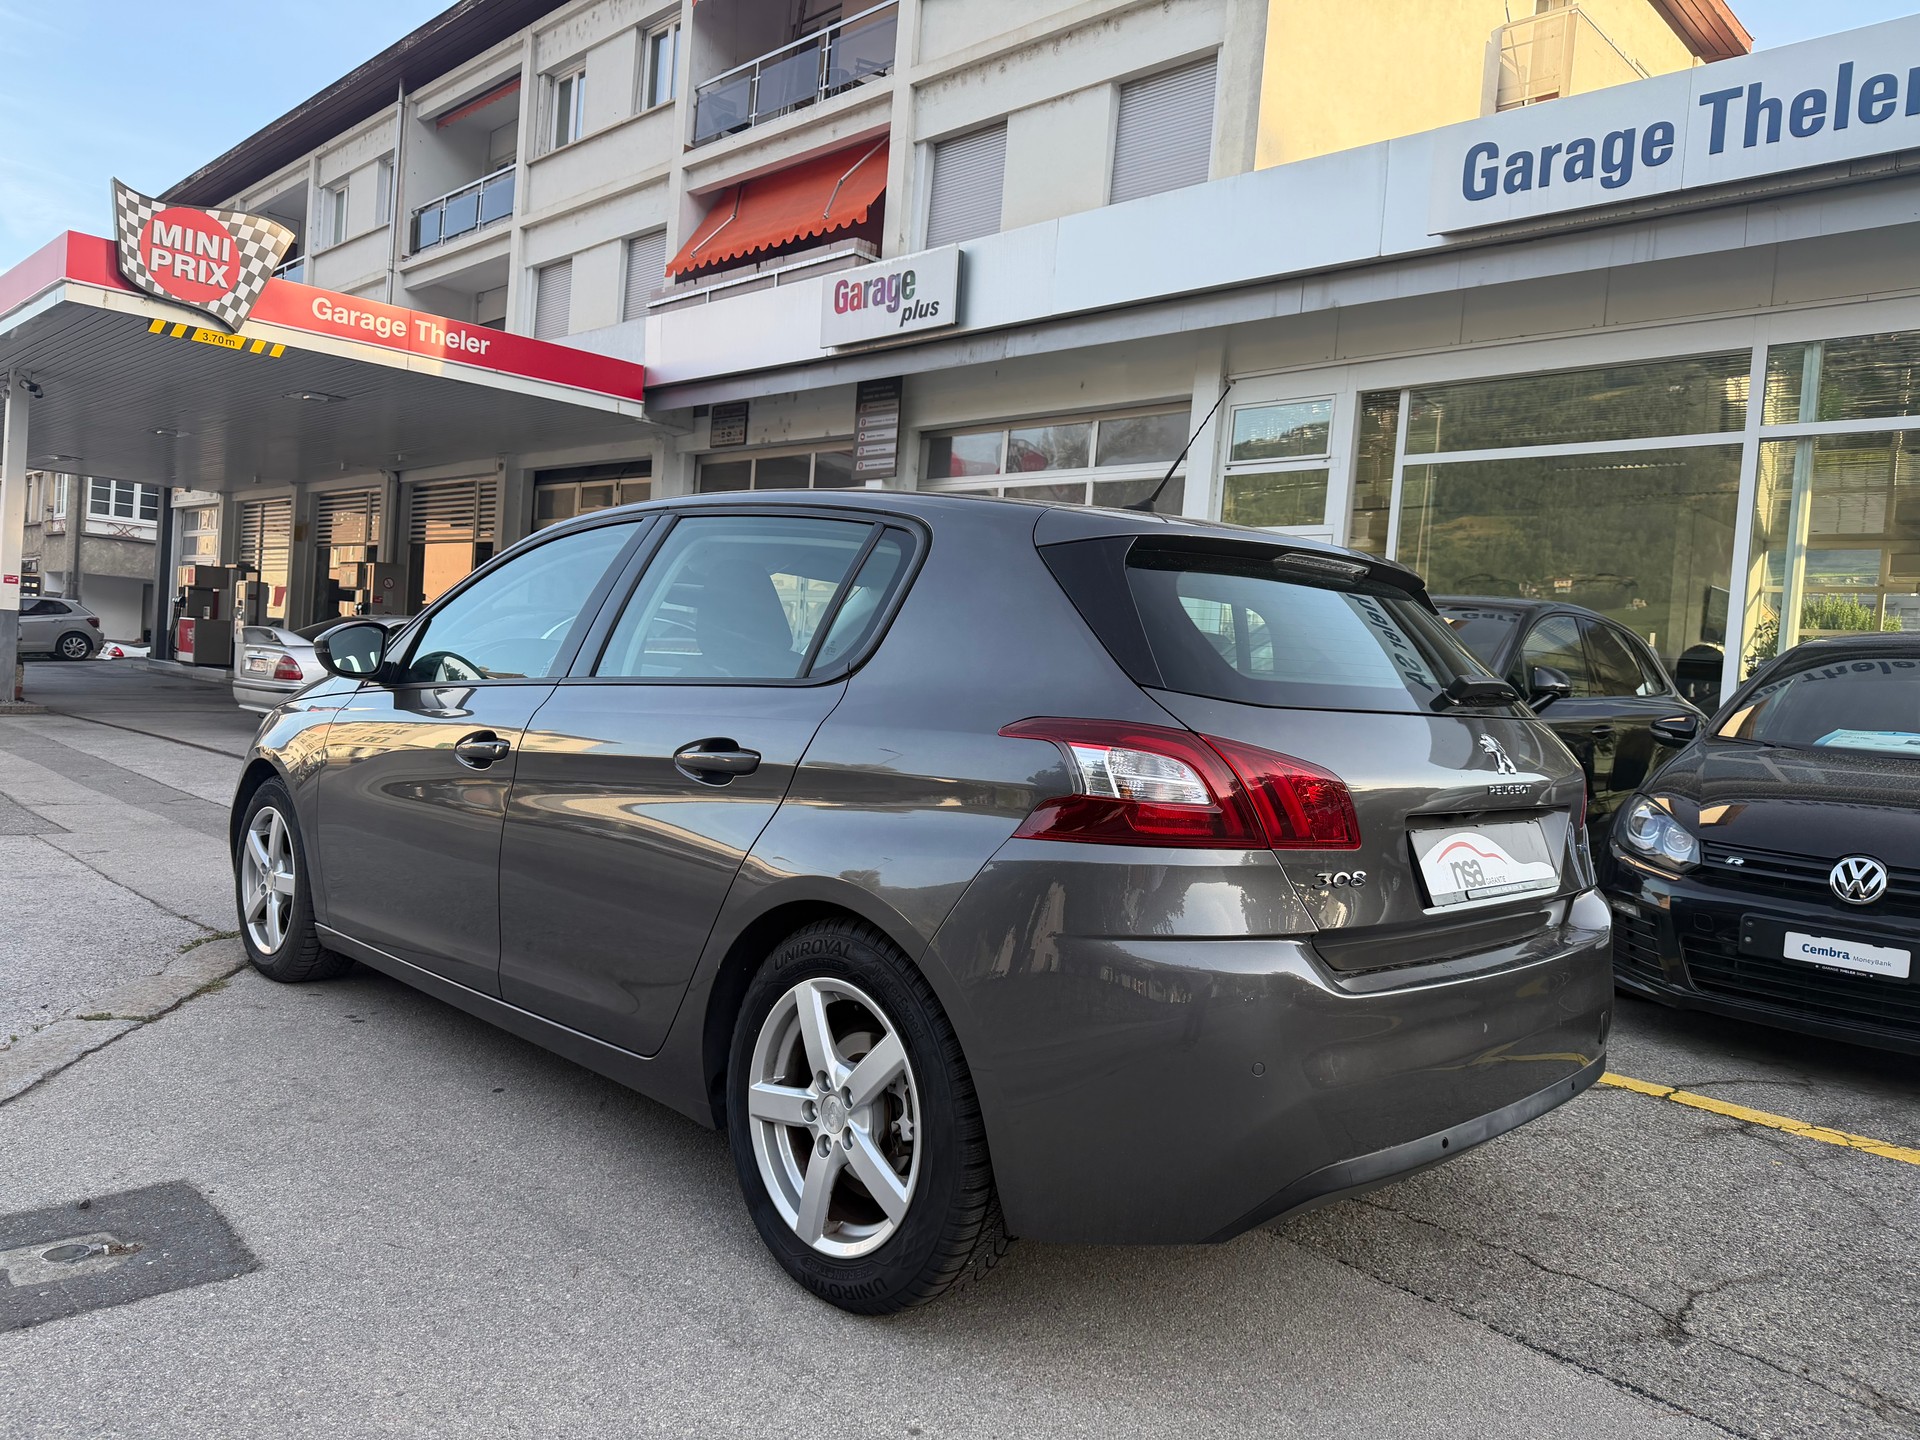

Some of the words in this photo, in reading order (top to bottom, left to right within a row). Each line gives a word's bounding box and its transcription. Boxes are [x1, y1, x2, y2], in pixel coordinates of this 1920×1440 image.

[1462, 120, 1675, 201] Garage
[152, 219, 231, 263] MINI
[150, 247, 230, 289] PRIX
[834, 269, 916, 315] Garage
[311, 297, 407, 339] Garage
[415, 319, 490, 355] Theler
[899, 299, 940, 328] plus
[1487, 784, 1532, 796] PEUGEOT
[1312, 871, 1367, 890] 308
[1450, 859, 1486, 889] nsa
[773, 939, 852, 971] UNIROYAL
[1801, 943, 1850, 961] Cembra
[1852, 955, 1892, 968] MoneyBank
[797, 1267, 888, 1301] UNIROYAL
